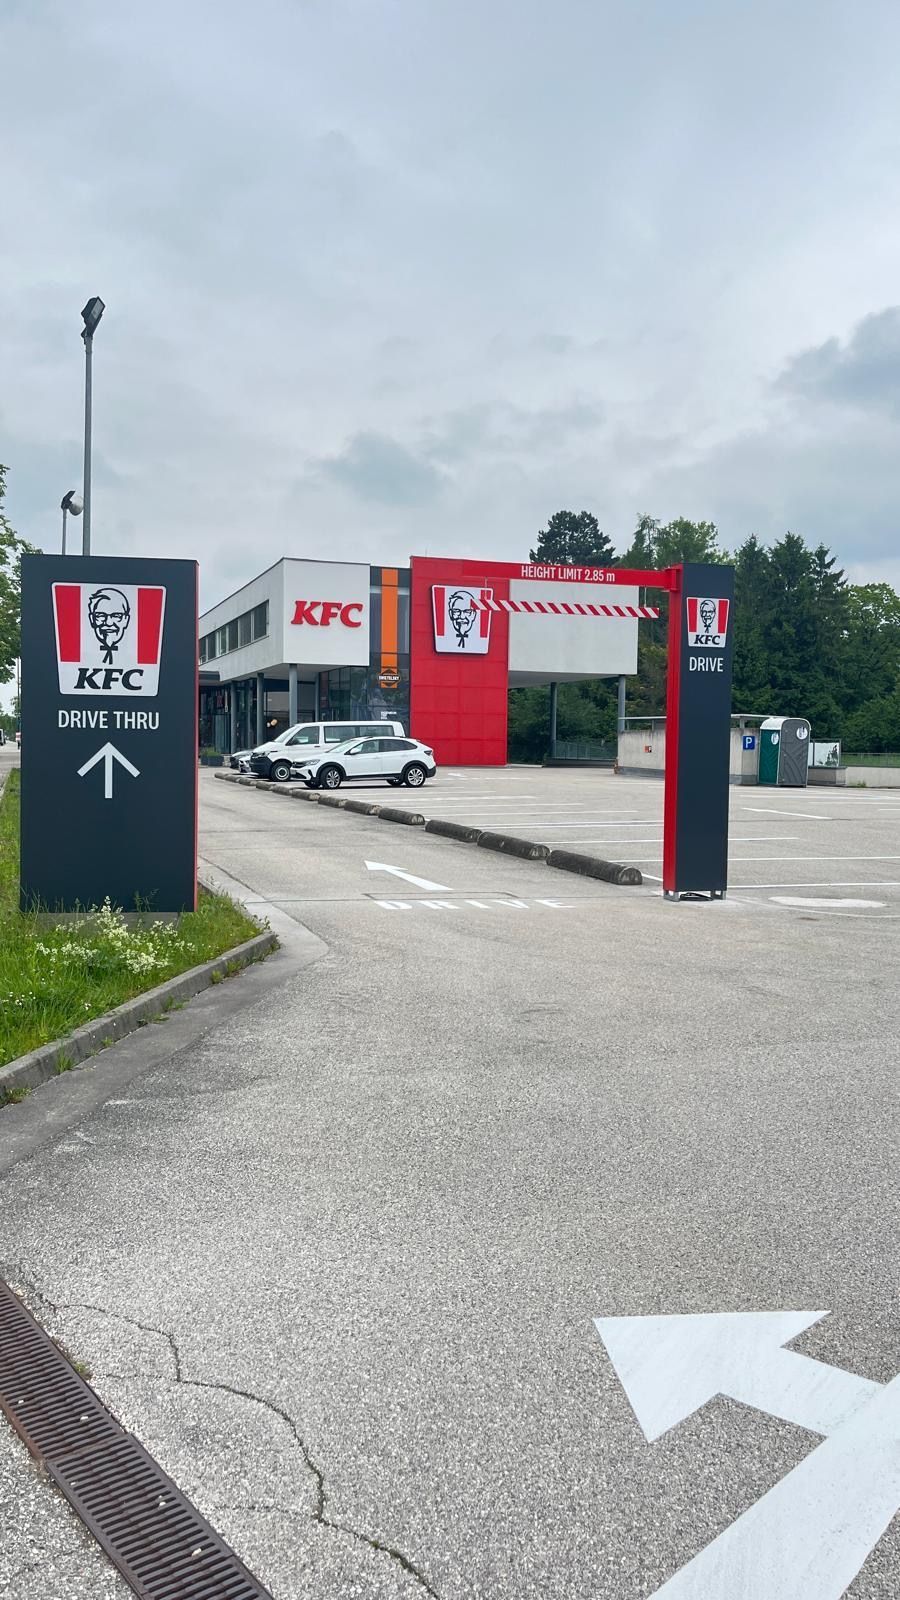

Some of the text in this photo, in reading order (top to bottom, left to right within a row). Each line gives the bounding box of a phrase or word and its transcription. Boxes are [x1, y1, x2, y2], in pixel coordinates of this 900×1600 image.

[521, 565, 615, 582] HEIGHT LIMIT 2.85 m
[290, 600, 364, 628] KFC
[693, 634, 721, 646] KFC
[689, 656, 724, 672] DRIVE
[73, 667, 144, 691] KFC
[58, 709, 160, 730] DRIVE THRU
[745, 737, 753, 749] P
[374, 899, 576, 910] DRIVE
